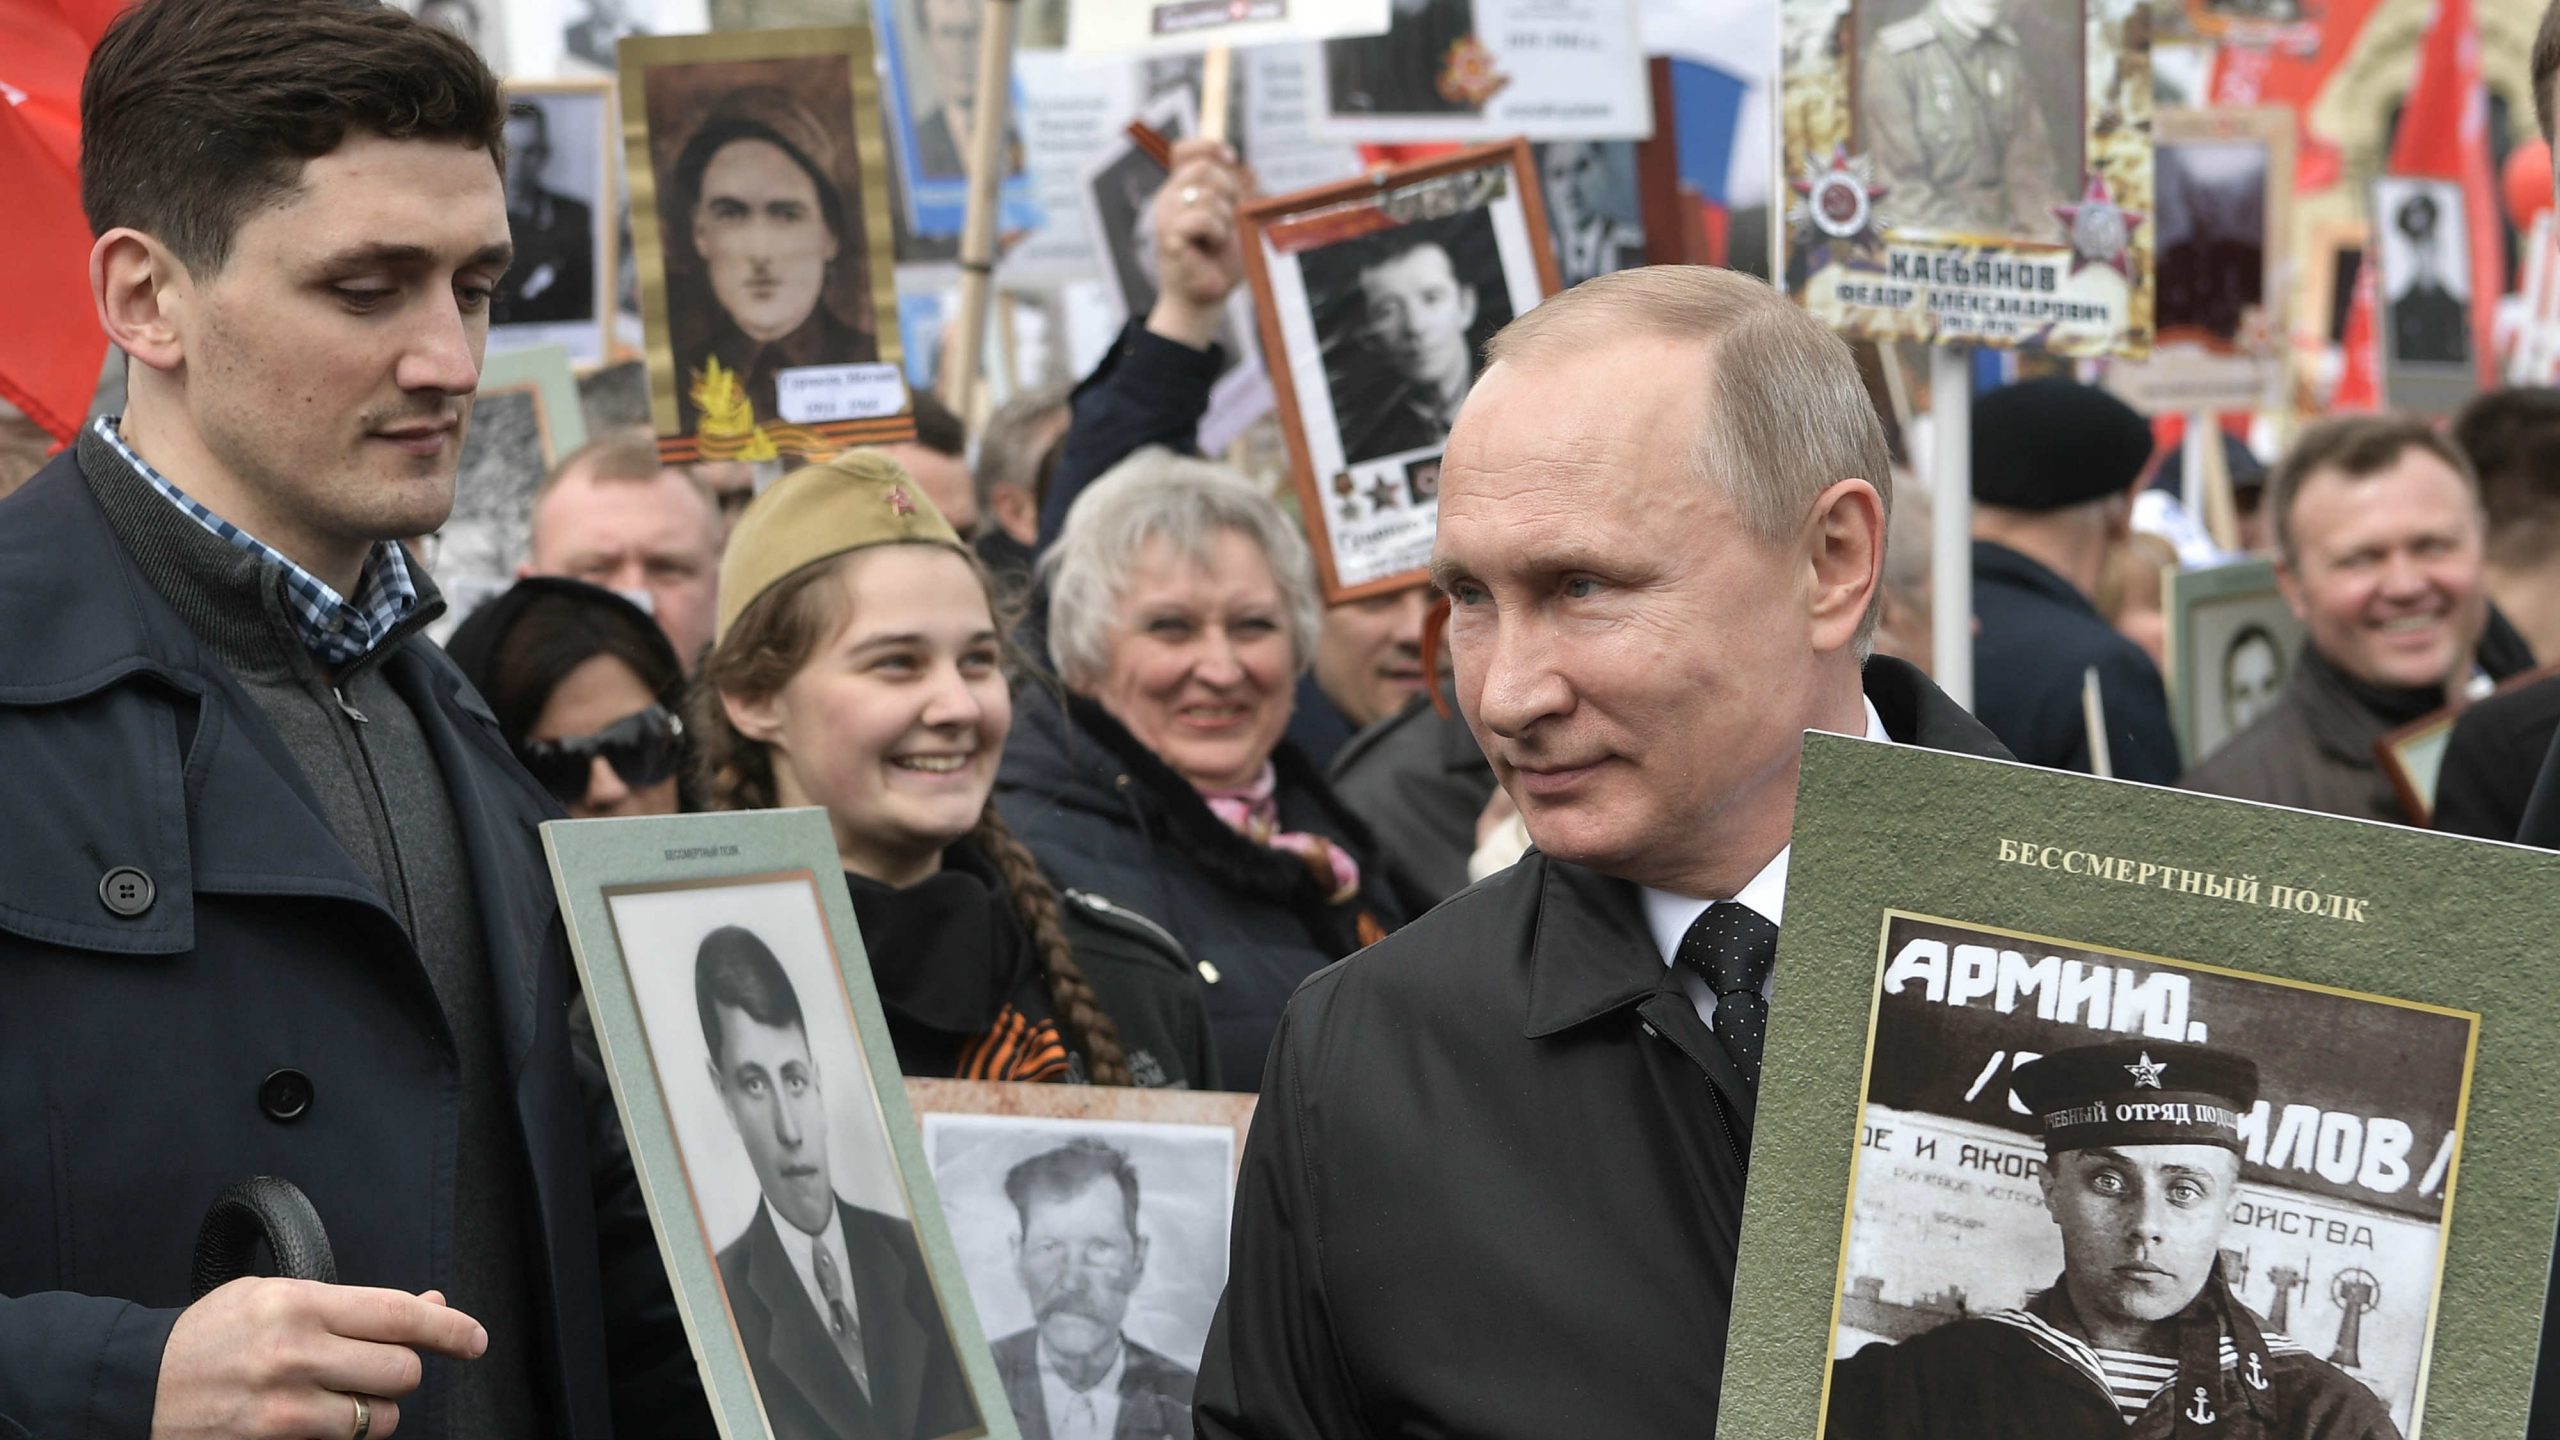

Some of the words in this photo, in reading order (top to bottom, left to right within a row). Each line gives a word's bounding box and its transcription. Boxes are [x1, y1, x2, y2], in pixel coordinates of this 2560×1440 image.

[1889, 252, 2056, 292] КАСЬЯНОВ
[1837, 284, 1913, 307] ФЕДОР
[1997, 838, 2258, 904] БЕССМЕРТНЫЙ
[2268, 884, 2369, 923] ПОЛК
[1884, 938, 2207, 1043] АРМИЮ.
[2116, 1103, 2192, 1126] ОТРЯД
[1915, 1135, 1937, 1160] И
